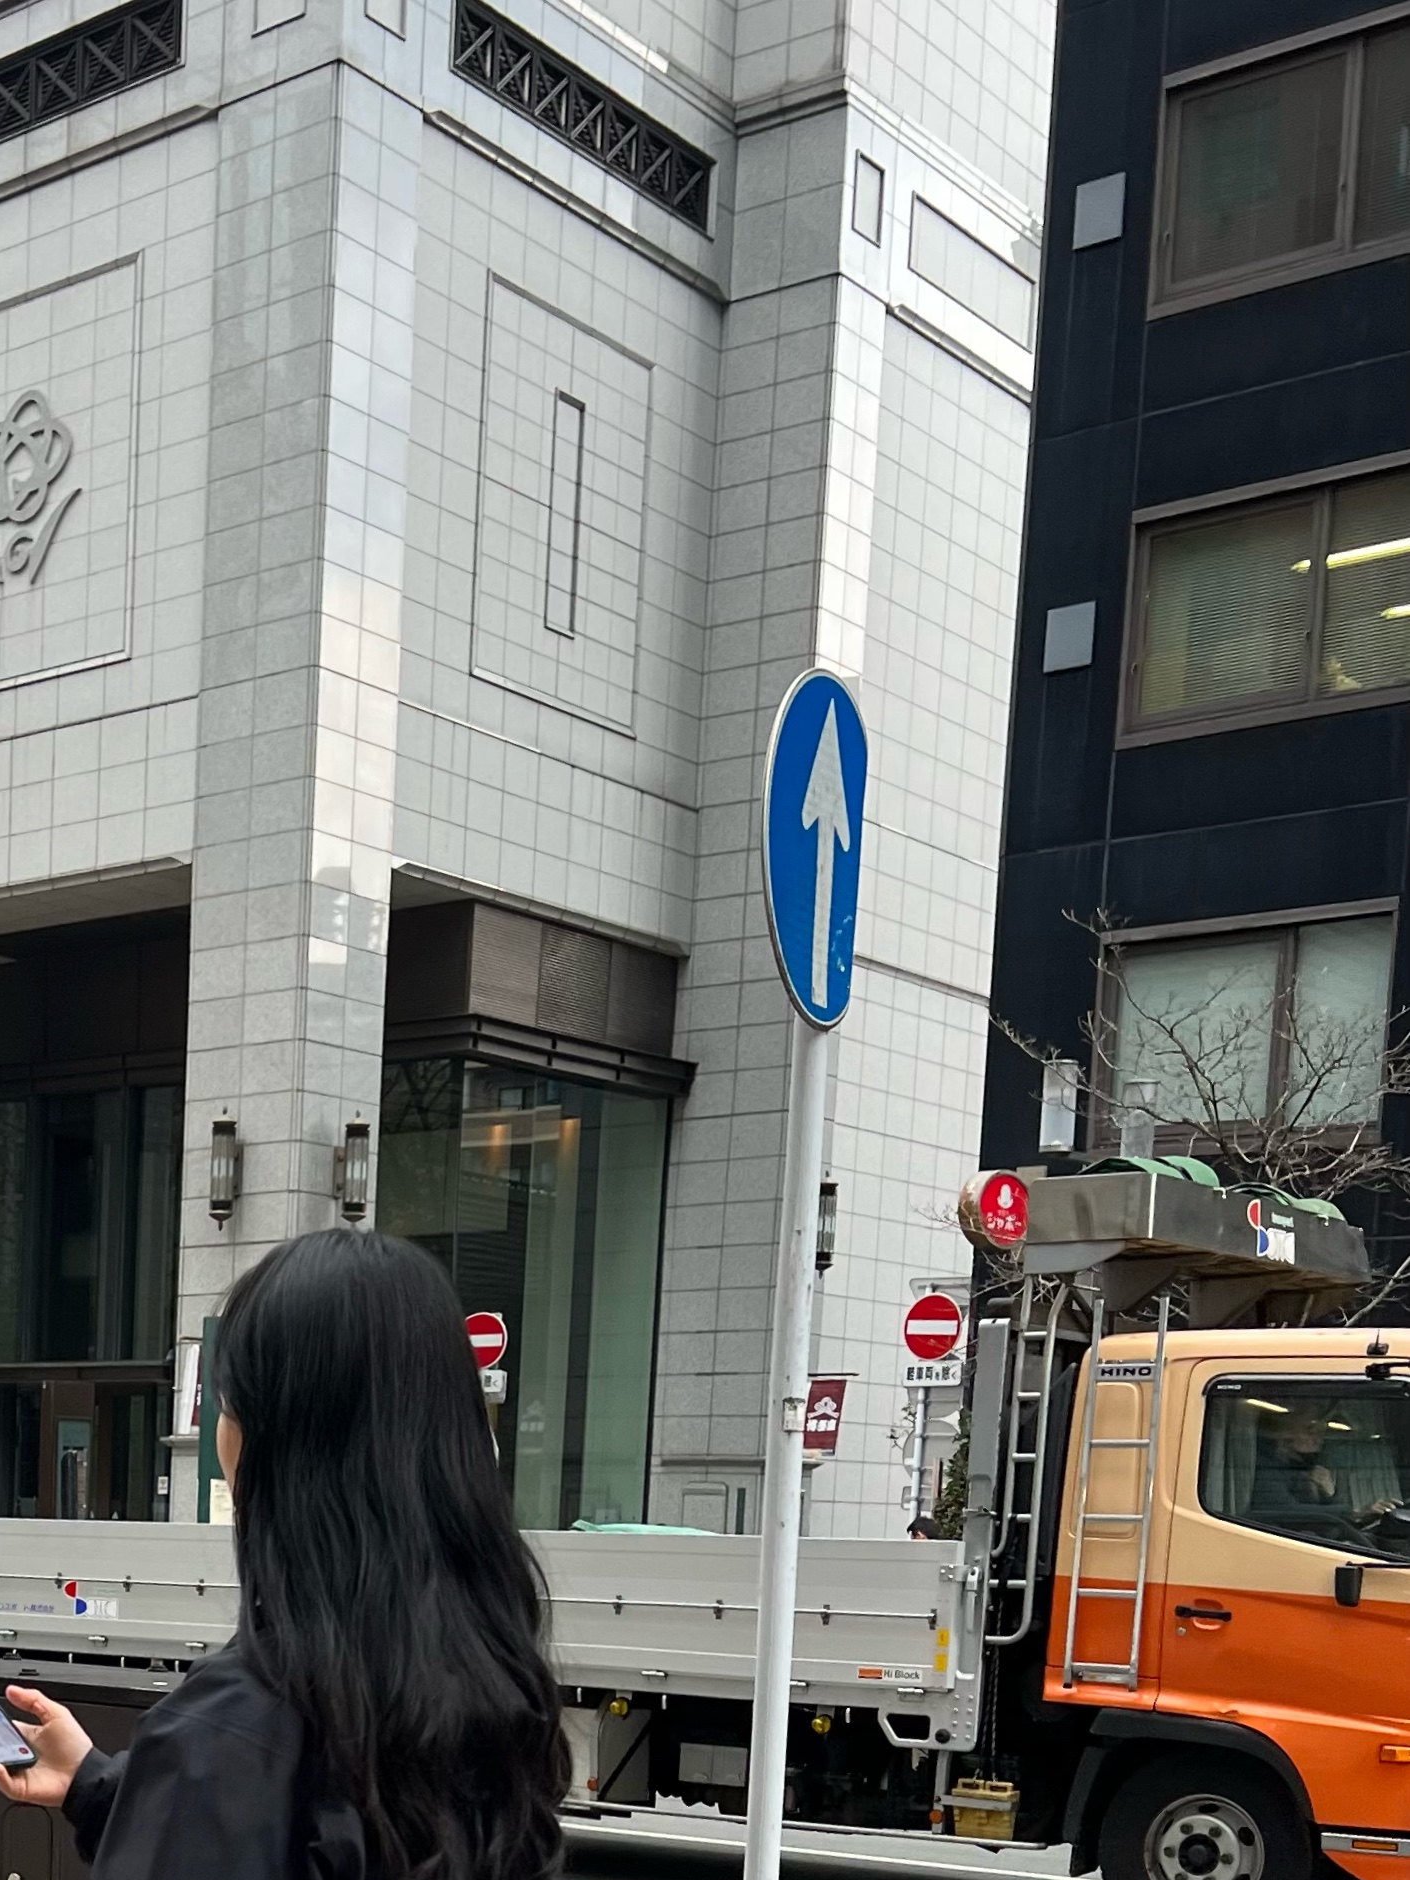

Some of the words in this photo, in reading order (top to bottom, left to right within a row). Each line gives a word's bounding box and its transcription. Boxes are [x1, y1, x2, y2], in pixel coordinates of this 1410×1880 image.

[1100, 1366, 1152, 1377] HINO
[884, 1669, 893, 1679] Hi
[895, 1669, 920, 1680] Block
